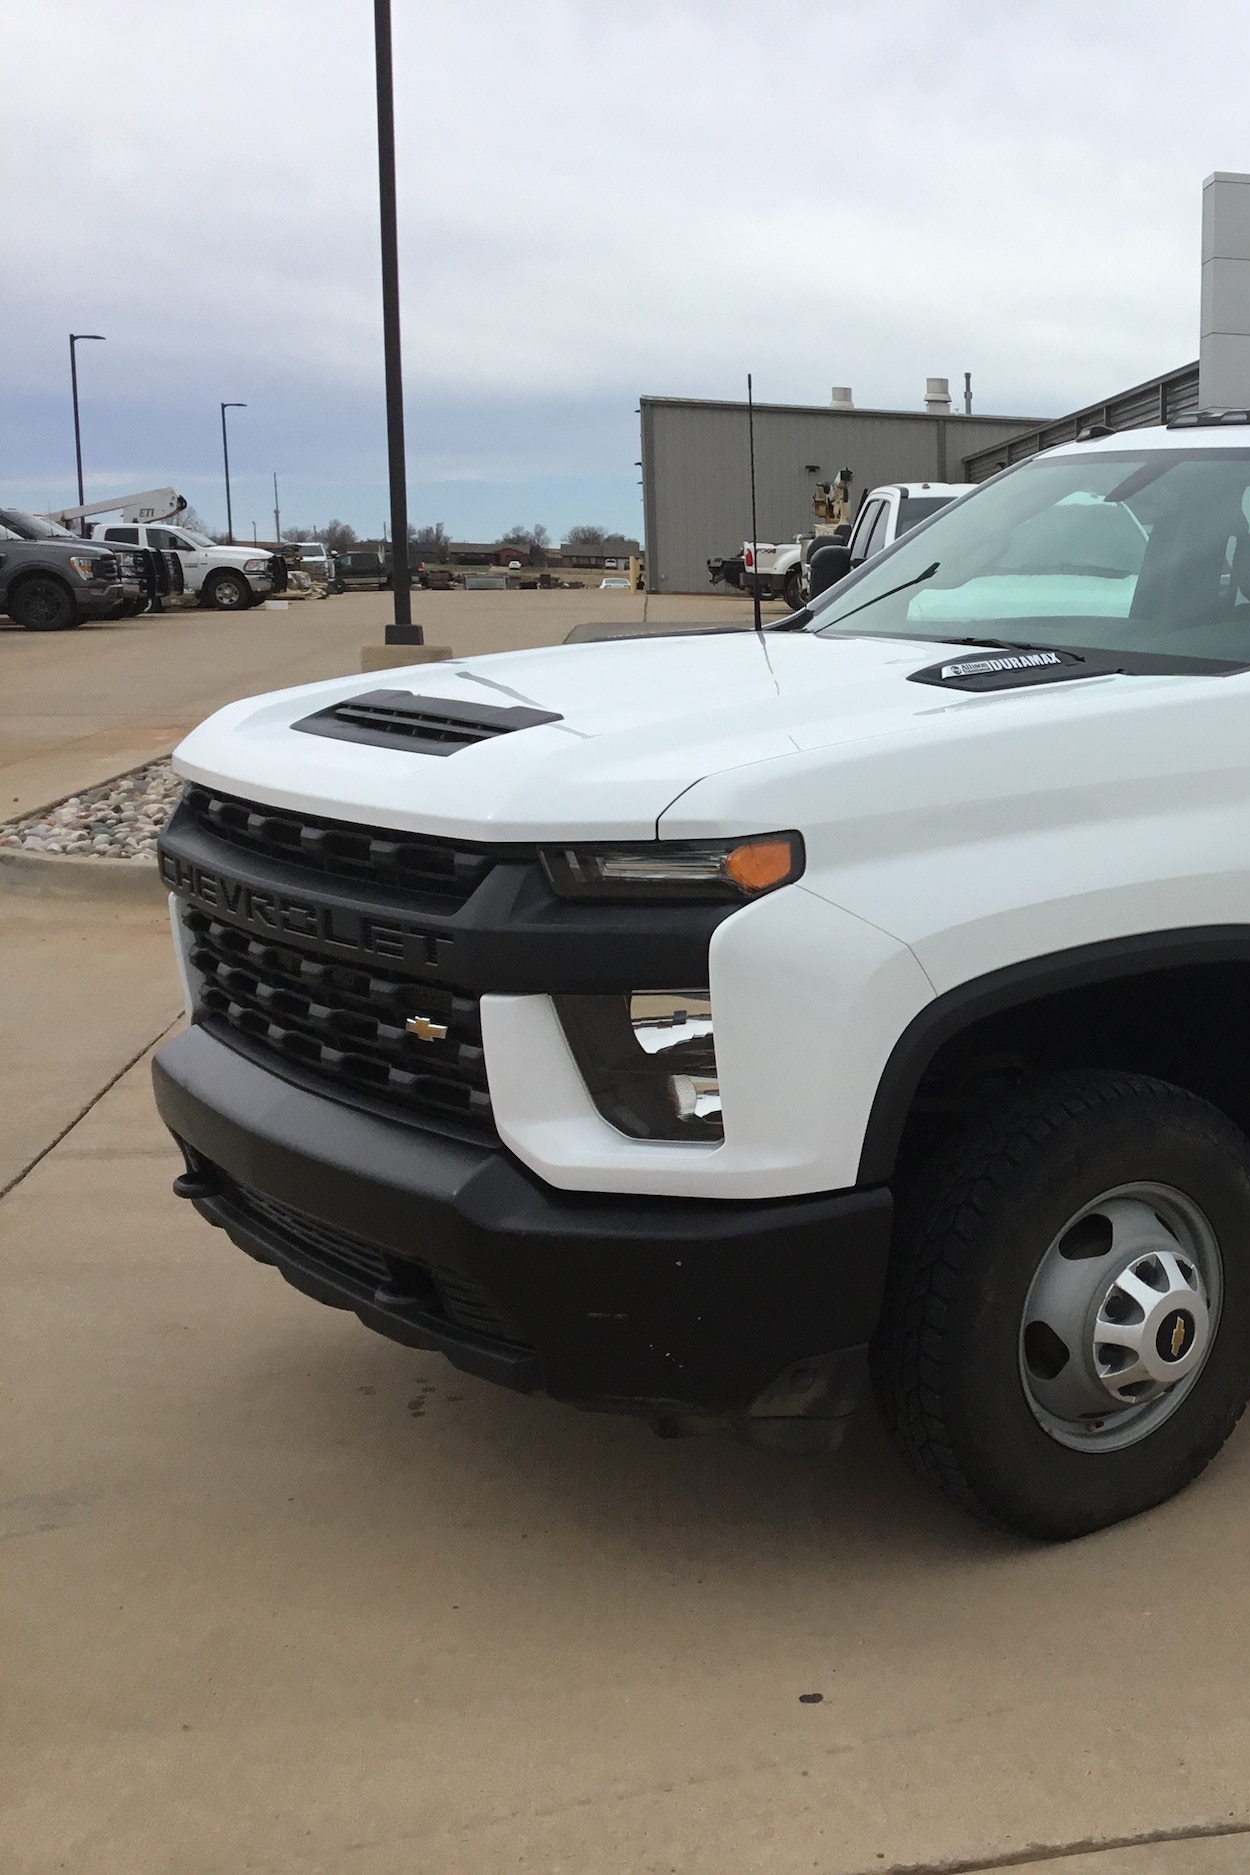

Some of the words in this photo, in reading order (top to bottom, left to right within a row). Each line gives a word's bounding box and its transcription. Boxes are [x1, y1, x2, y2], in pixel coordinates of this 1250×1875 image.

[139, 508, 155, 518] ETI
[961, 661, 989, 672] Allison
[990, 652, 1062, 671] DURAMAX
[159, 848, 455, 967] CHEVROLET
